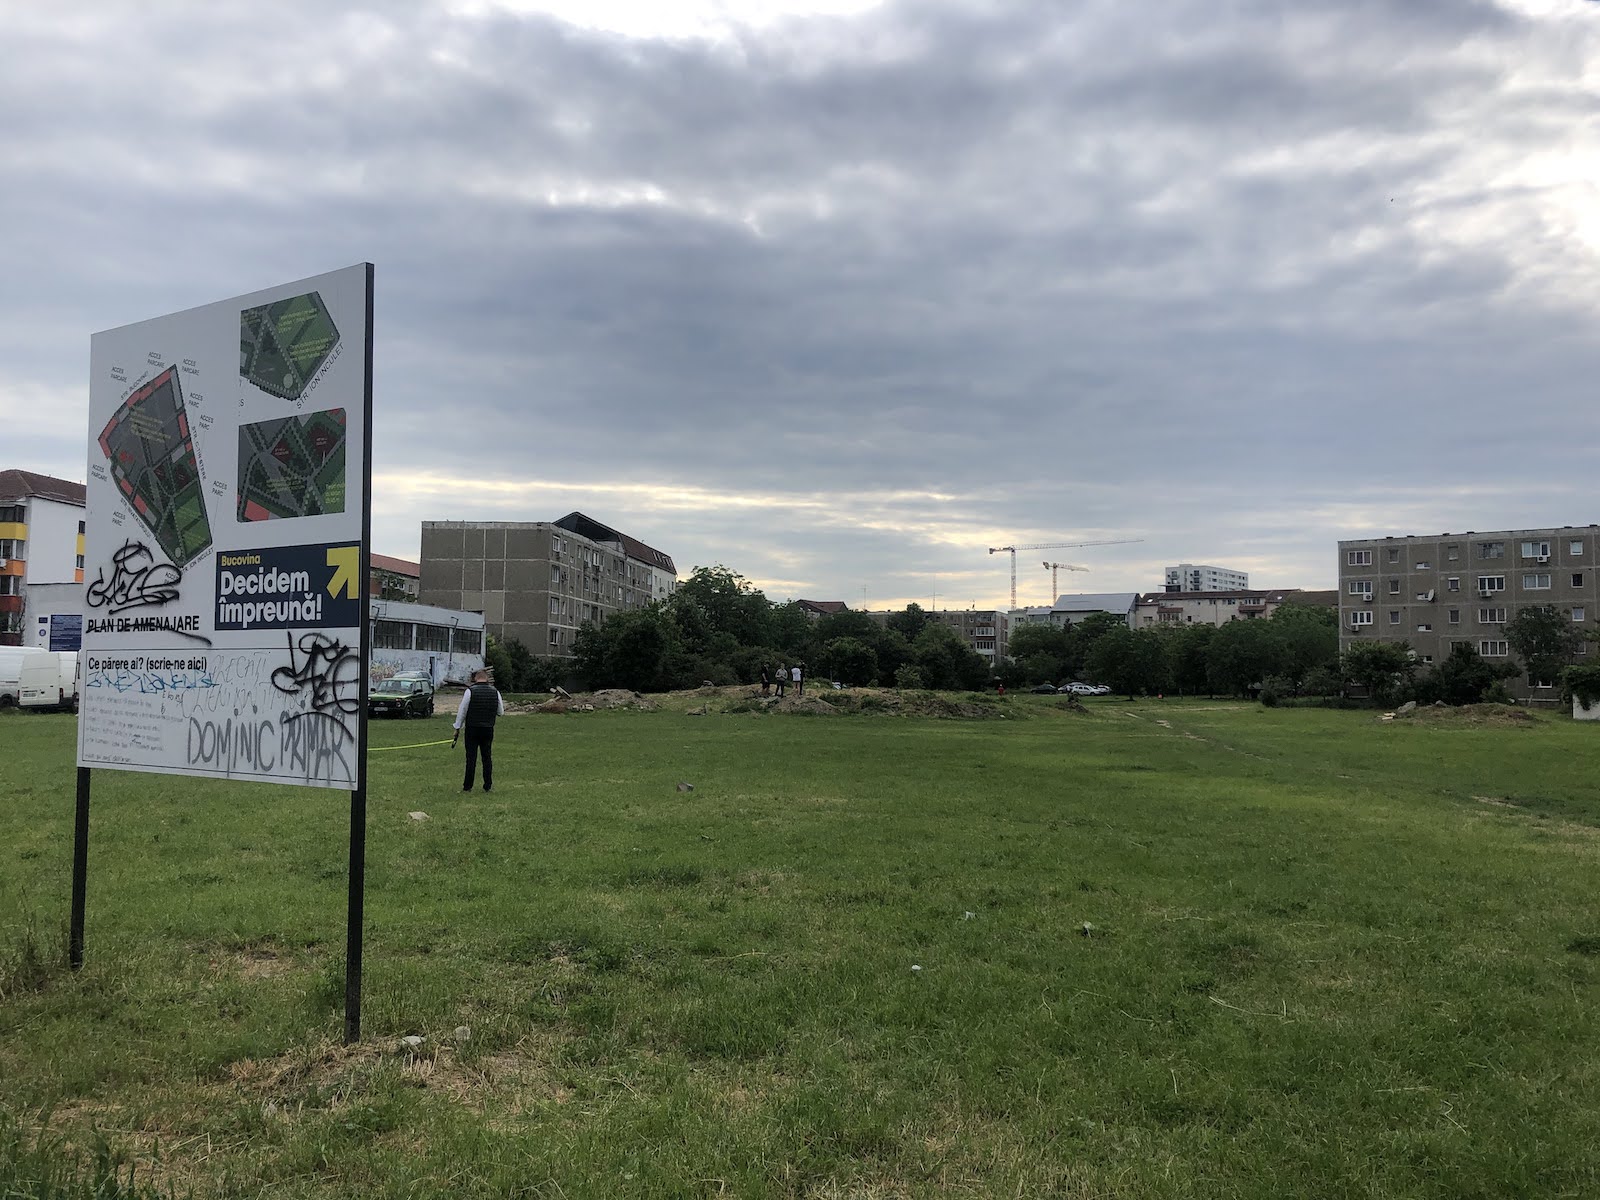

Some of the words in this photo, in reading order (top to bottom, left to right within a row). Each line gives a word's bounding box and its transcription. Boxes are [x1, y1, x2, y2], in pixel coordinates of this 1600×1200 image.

[310, 376, 320, 391] ION
[320, 342, 344, 376] INCULET
[221, 553, 260, 566] Bucovina
[220, 566, 309, 595] Decidem
[88, 619, 114, 633] PLAN
[117, 618, 130, 632] DE
[133, 615, 200, 632] AMENAJARE
[218, 592, 322, 628] împreună!
[88, 657, 100, 670] Ce
[102, 657, 128, 672] părere
[130, 657, 144, 670] ai?
[146, 657, 185, 672] (scrie-ne
[188, 657, 207, 672] aici)
[188, 705, 275, 776] DOMINIC
[280, 703, 352, 784] PRIMAR
